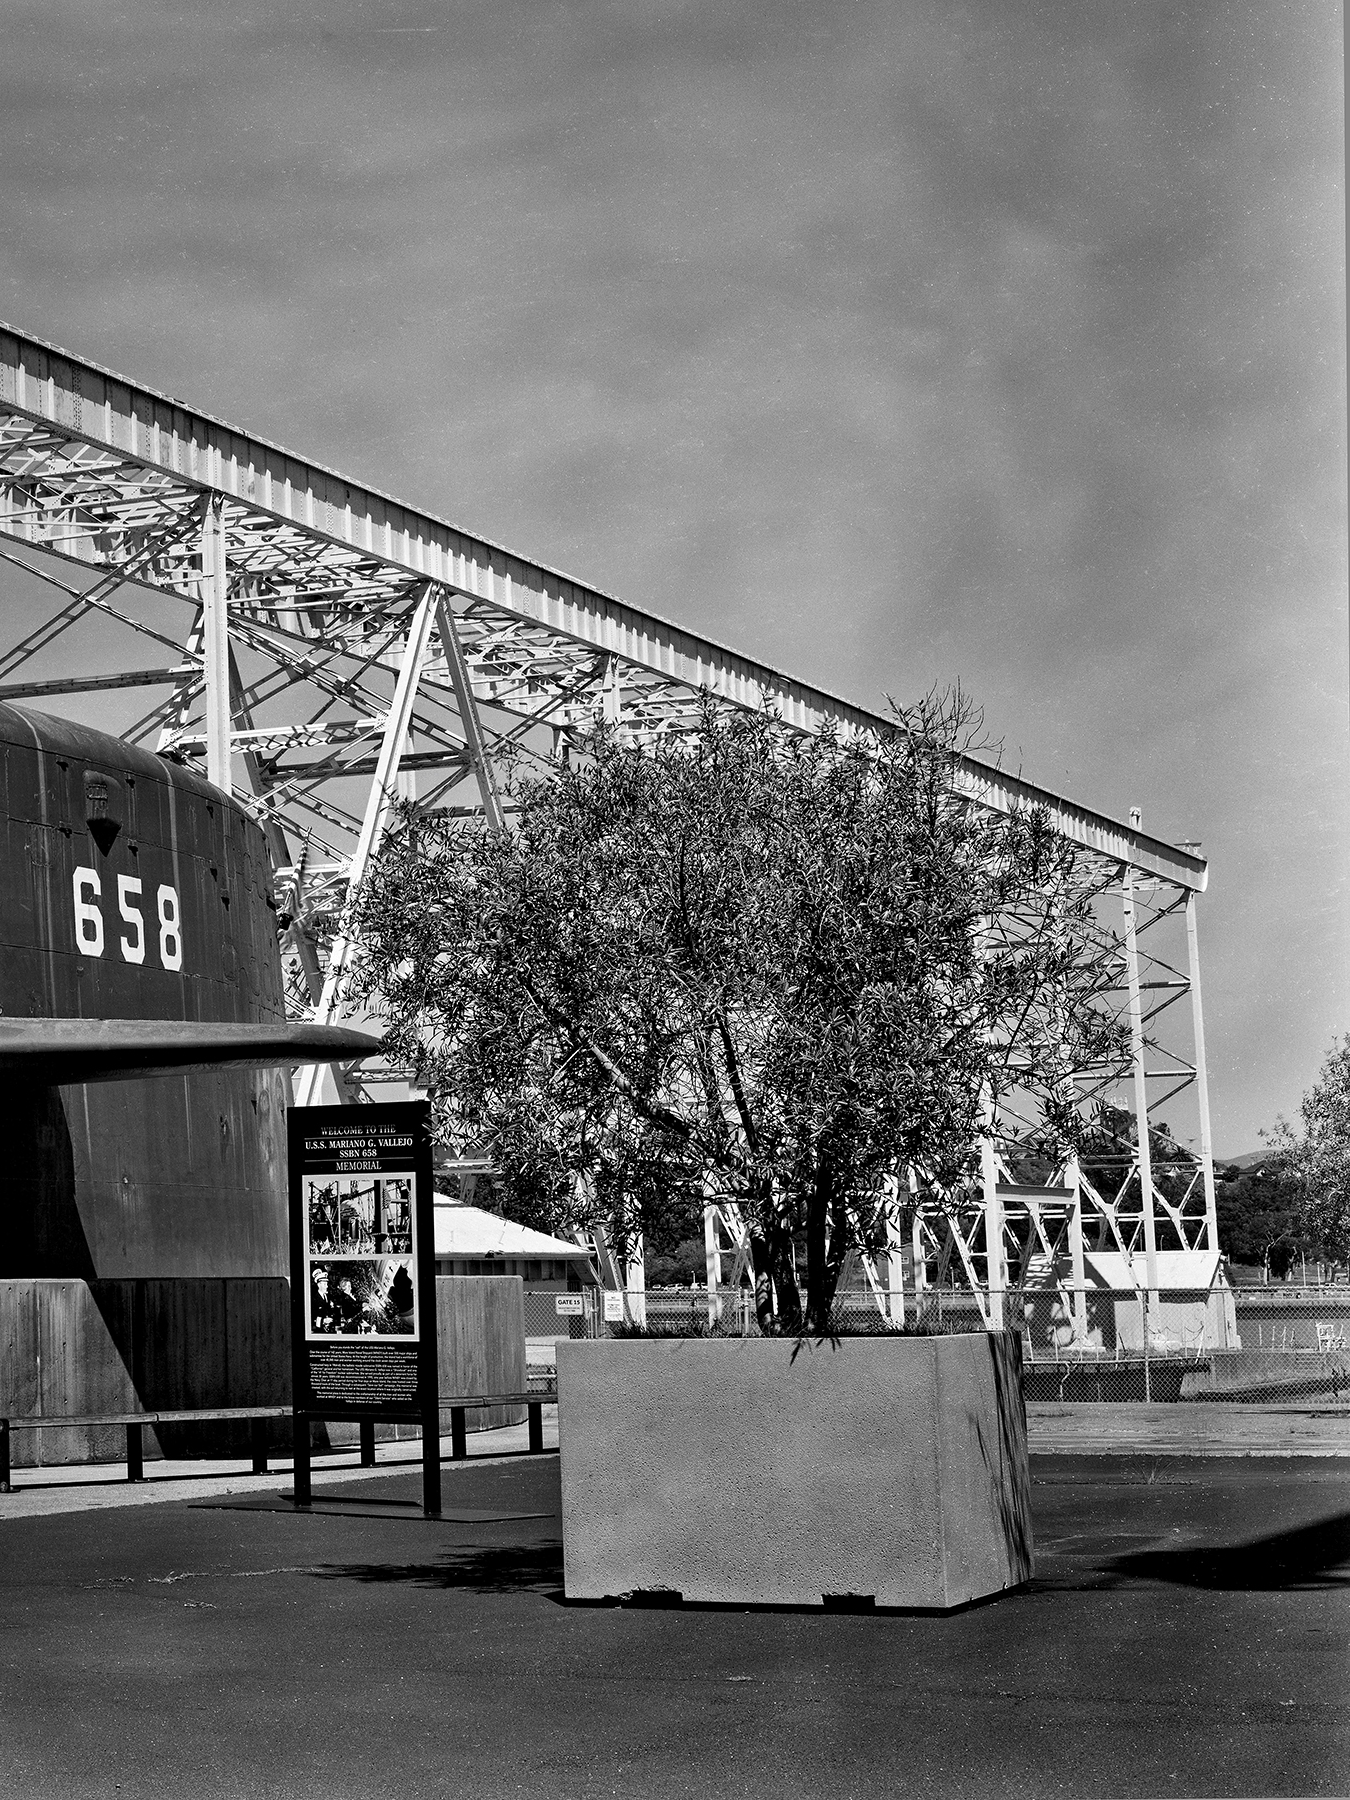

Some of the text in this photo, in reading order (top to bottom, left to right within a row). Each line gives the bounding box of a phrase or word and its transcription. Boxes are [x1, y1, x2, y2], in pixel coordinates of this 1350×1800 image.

[73, 866, 182, 971] 658
[321, 1124, 396, 1135] WELCOME TO THE
[305, 1138, 413, 1150] U.S.S. MARIANO G. VALLEJO
[339, 1149, 377, 1158] SSBN 658
[336, 1161, 382, 1171] MEMORIAL
